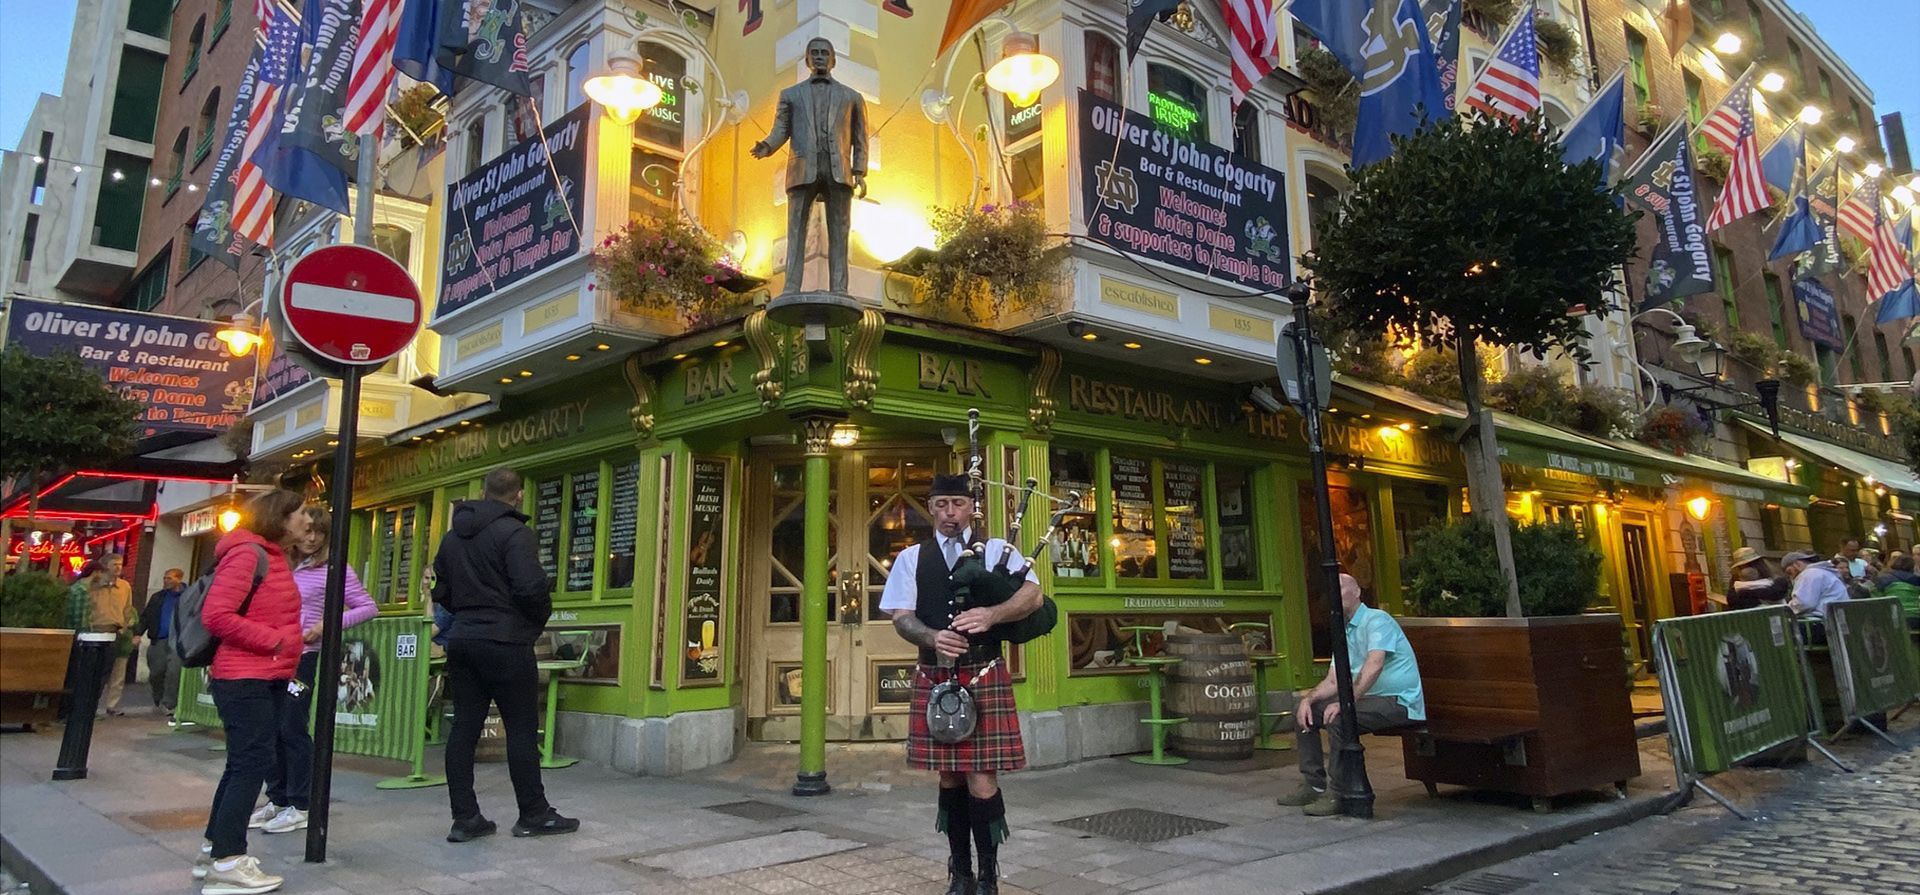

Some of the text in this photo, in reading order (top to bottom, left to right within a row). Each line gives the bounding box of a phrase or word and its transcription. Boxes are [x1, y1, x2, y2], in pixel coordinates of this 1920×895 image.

[649, 73, 674, 90] LIVE
[1155, 106, 1189, 131] IRISH
[453, 120, 581, 212] Oliver St John Gogarty
[1092, 105, 1277, 203] Oliver St John Gogarty
[475, 203, 489, 221] Bar
[499, 169, 547, 207] Restaurant
[1140, 157, 1242, 207] Bar & Restaurant
[483, 202, 531, 241] Welcomes
[1159, 186, 1228, 228] Welcomes
[1671, 190, 1697, 223] John
[476, 224, 534, 267] Notre Dame
[1154, 207, 1236, 251] Notre Dame
[499, 257, 510, 278] to
[513, 236, 549, 269] Temple
[551, 229, 573, 254] Bar
[1099, 213, 1284, 288] & supporters to Temple Bar
[25, 312, 101, 338] Oliver
[105, 321, 131, 342] St
[130, 325, 188, 348] John
[80, 346, 230, 372] Bar & Restaurant
[109, 367, 200, 388] Welcomes
[918, 351, 991, 398] BAR
[152, 389, 207, 407] Dame
[685, 357, 738, 405] BAR
[147, 407, 168, 421] to
[1070, 374, 1223, 432] RESTAURANT
[454, 430, 489, 463] JOHN
[498, 401, 590, 449] GOGARTY
[1242, 406, 1289, 439] THE
[694, 504, 721, 513] MUSIC
[697, 494, 720, 503] IRISH
[1124, 597, 1176, 607] TRADITIONAL
[1178, 598, 1200, 607] IRISH
[398, 645, 415, 656] BAR
[880, 678, 912, 689] GUINNE
